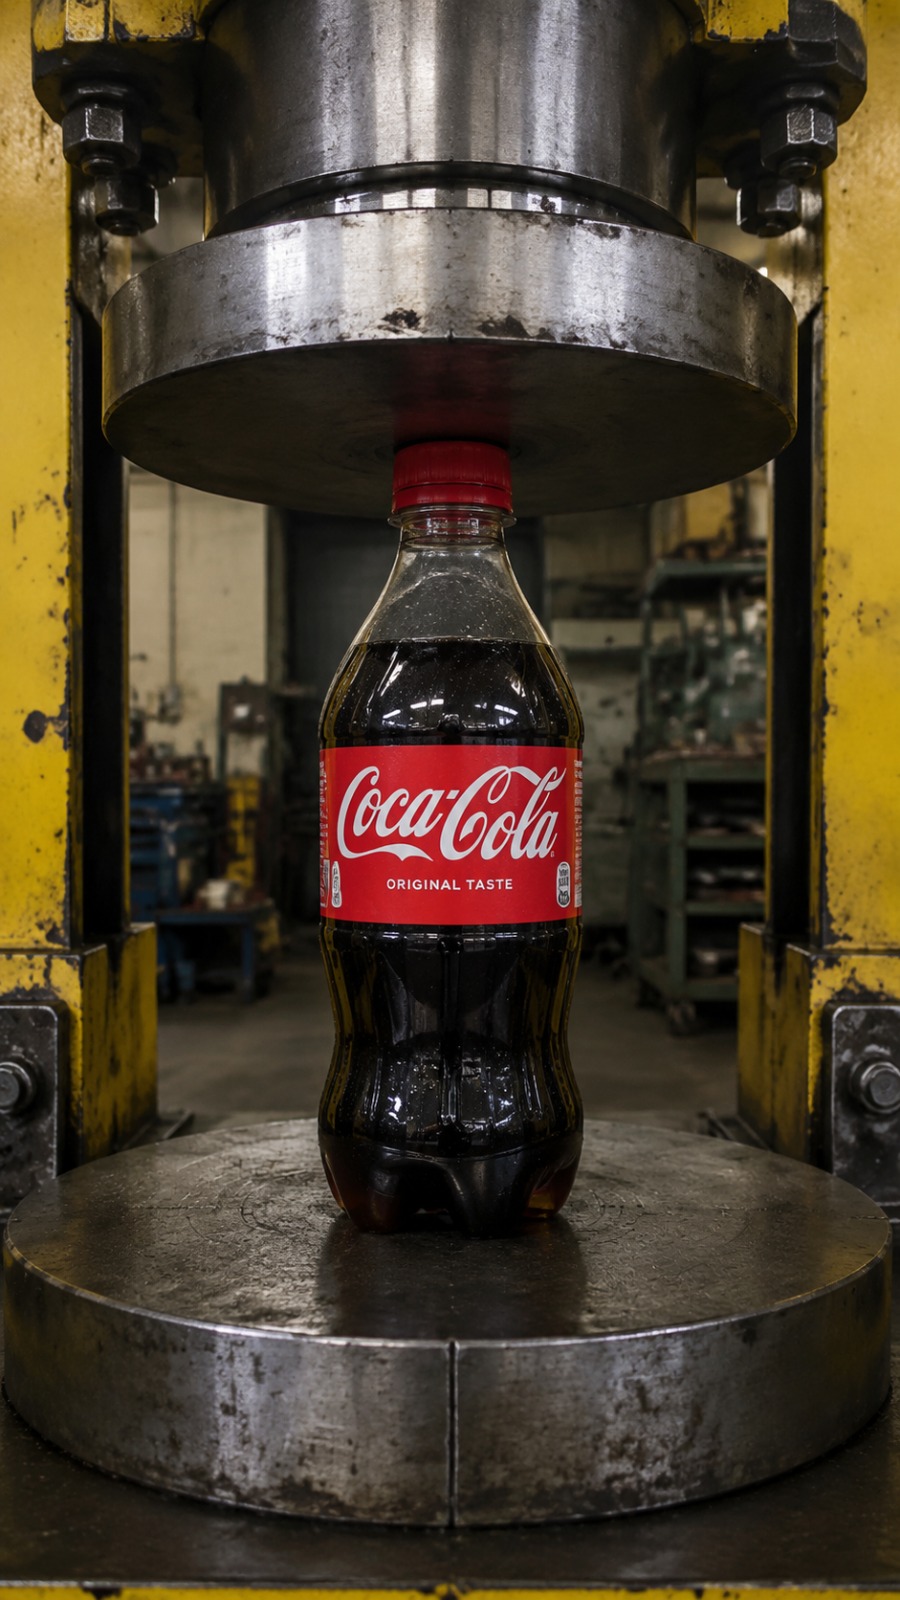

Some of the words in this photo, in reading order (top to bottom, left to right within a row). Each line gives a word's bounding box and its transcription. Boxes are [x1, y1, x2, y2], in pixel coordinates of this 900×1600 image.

[337, 765, 566, 862] Coca-Cola
[386, 878, 461, 891] ORIGINAL
[466, 878, 513, 890] TASTE
